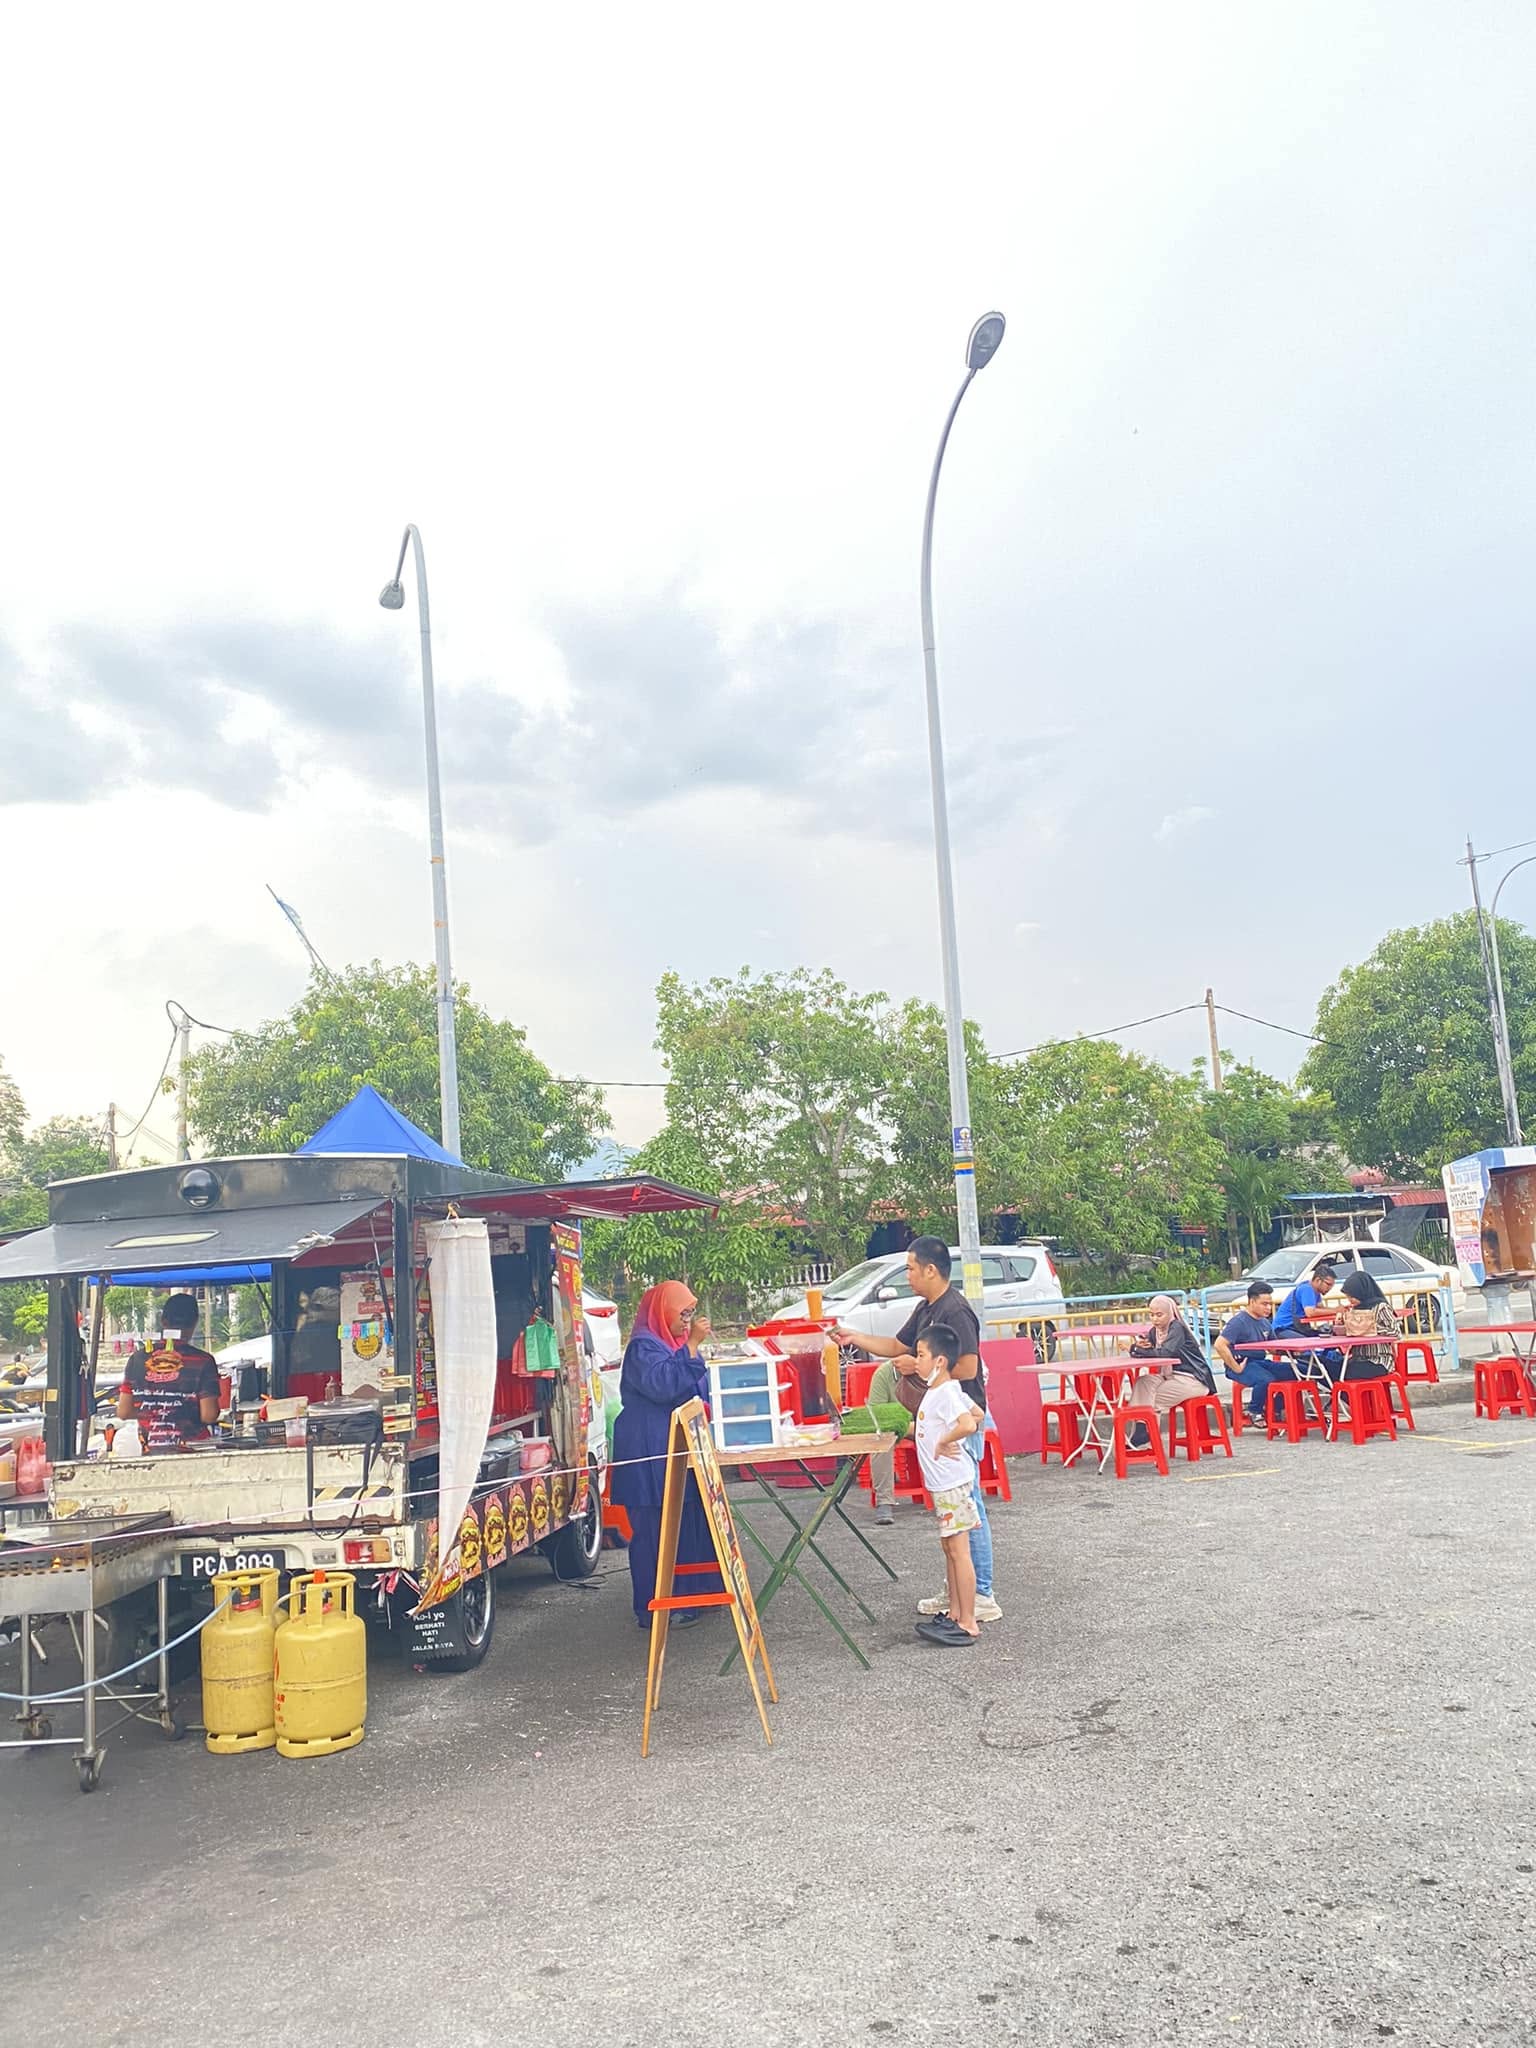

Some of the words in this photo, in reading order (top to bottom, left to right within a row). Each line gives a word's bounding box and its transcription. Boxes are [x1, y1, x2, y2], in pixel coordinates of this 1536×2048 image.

[193, 1556, 228, 1576] PCA
[235, 1553, 274, 1570] 809
[412, 1644, 433, 1652] JALAN
